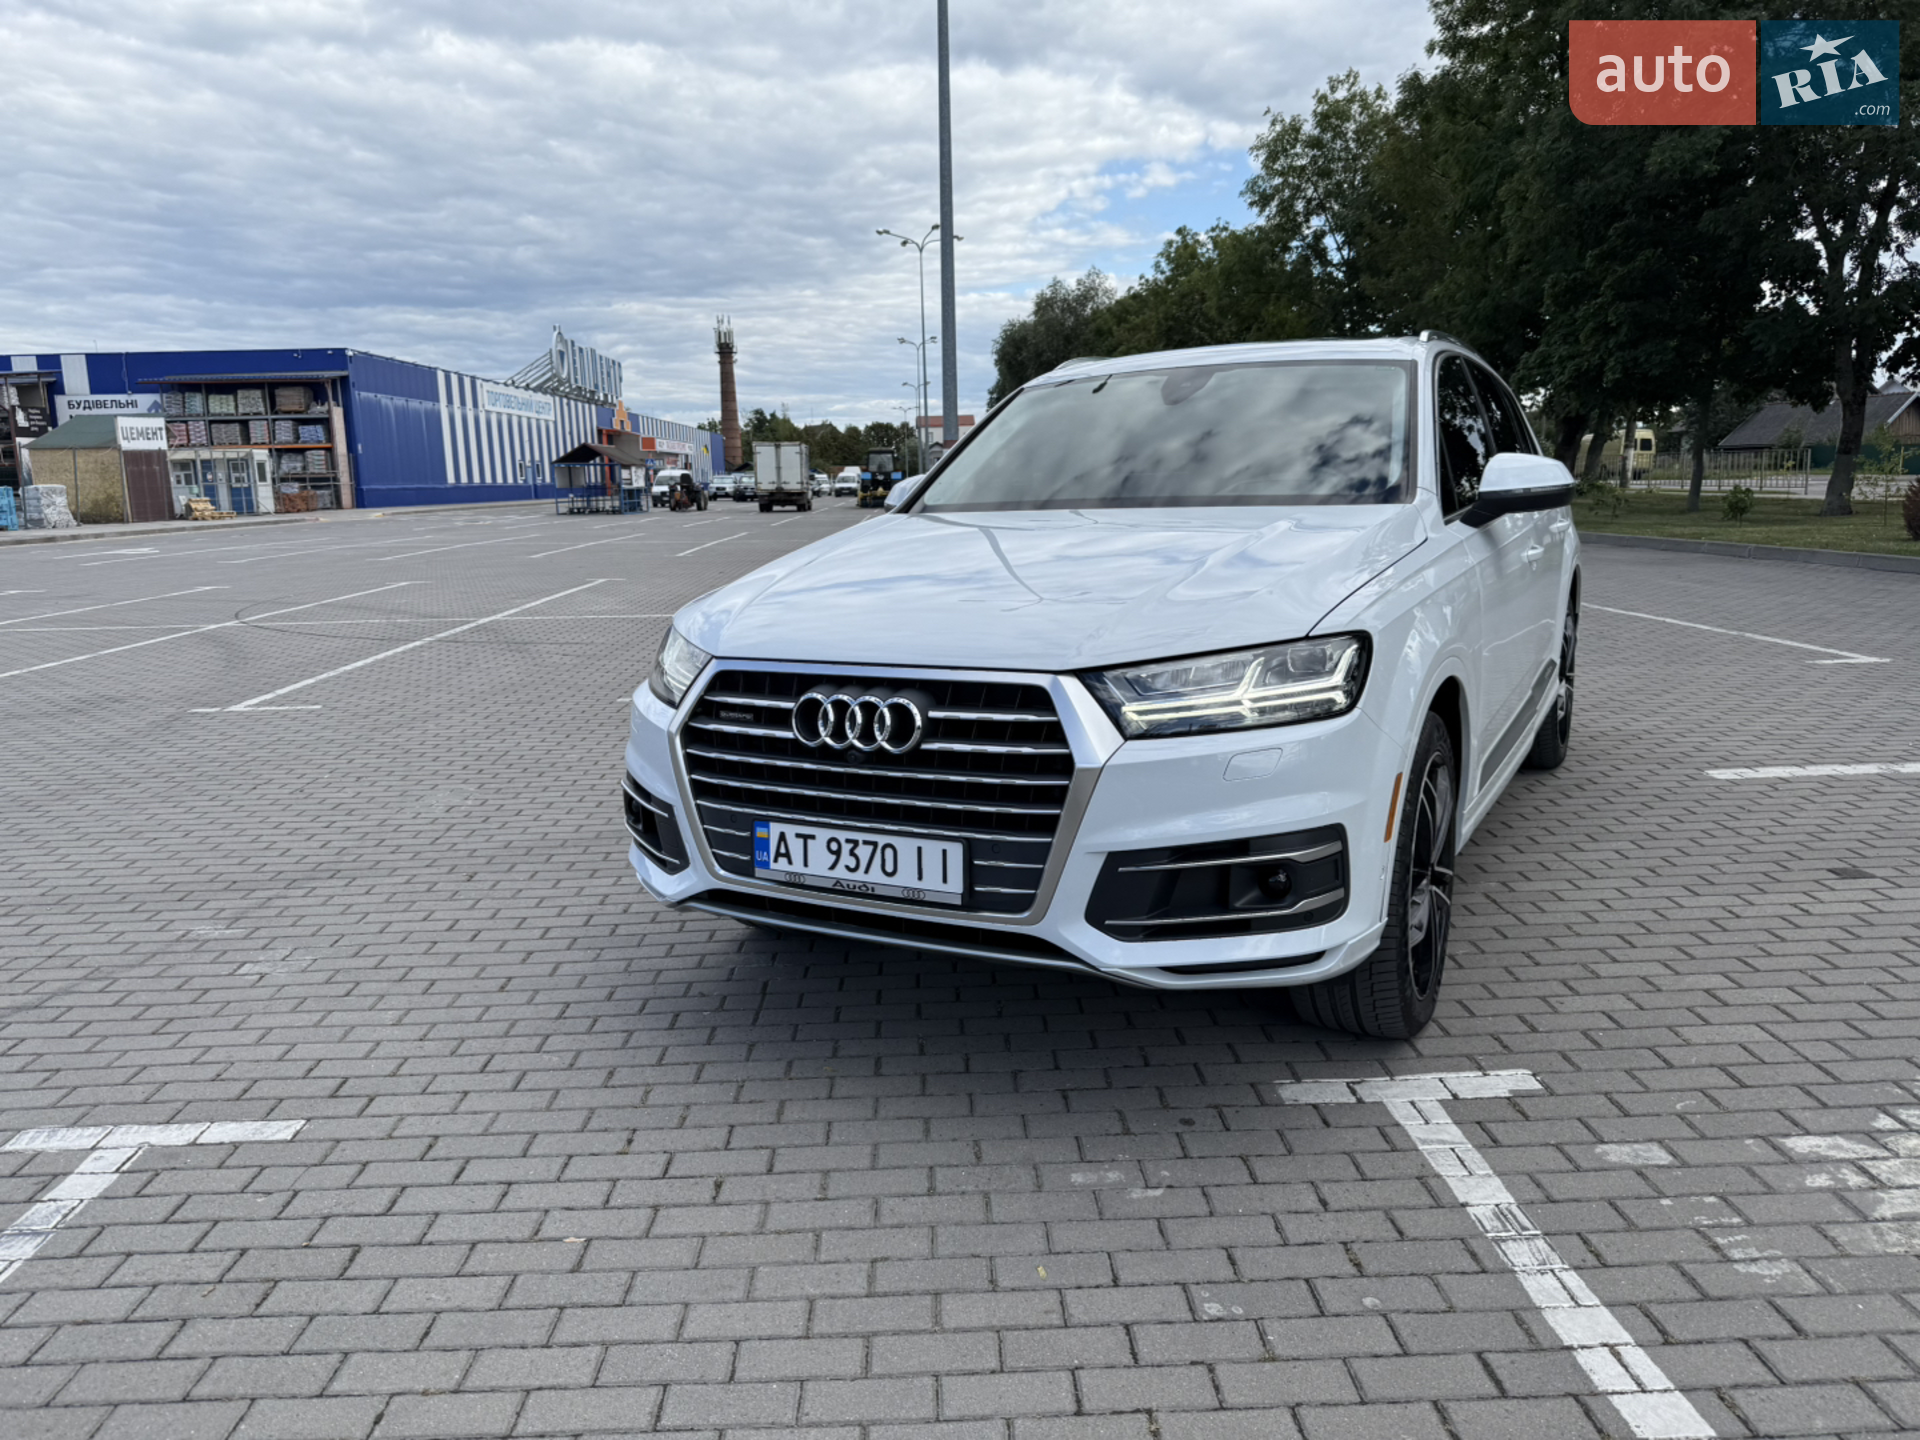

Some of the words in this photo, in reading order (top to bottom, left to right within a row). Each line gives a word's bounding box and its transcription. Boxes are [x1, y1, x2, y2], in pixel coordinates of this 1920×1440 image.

[67, 399, 138, 411] БУДІВЕЛЬНІ
[121, 426, 164, 443] ЦЕМЕНТ
[756, 850, 770, 862] UA
[773, 831, 816, 868] AT
[826, 836, 898, 878] 9370
[831, 879, 876, 893] Audi
